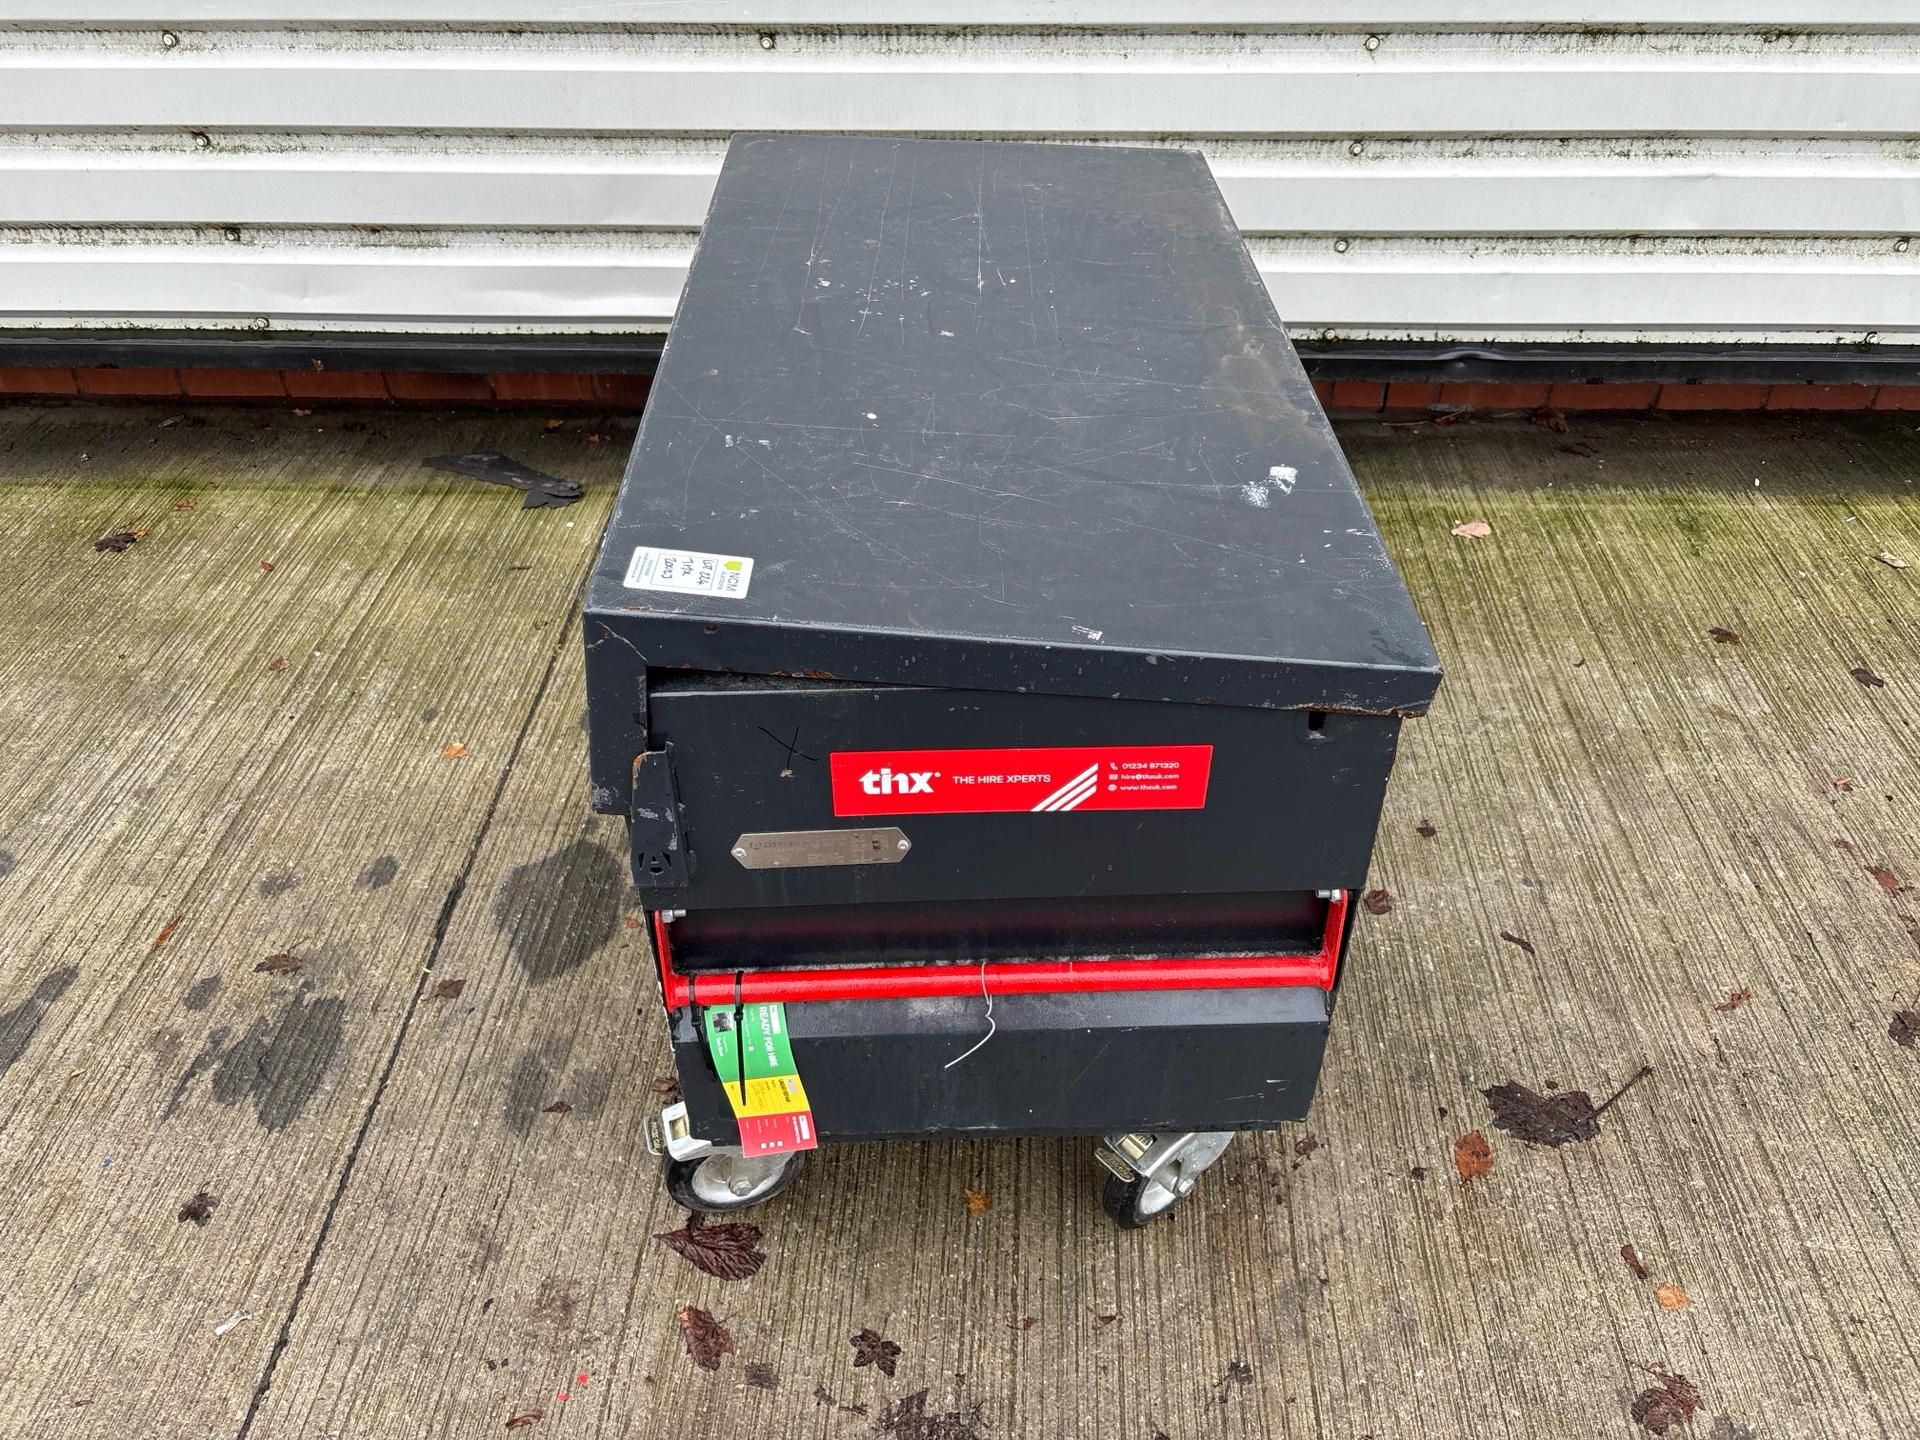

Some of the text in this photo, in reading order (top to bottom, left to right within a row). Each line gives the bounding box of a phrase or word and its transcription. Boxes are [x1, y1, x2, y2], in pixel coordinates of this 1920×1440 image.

[726, 571, 740, 592] NCM
[952, 774, 1051, 785] THE HIRE XPERTS
[759, 1006, 769, 1036] READY
[764, 1037, 774, 1053] FOR
[767, 1051, 779, 1068] HIRE
